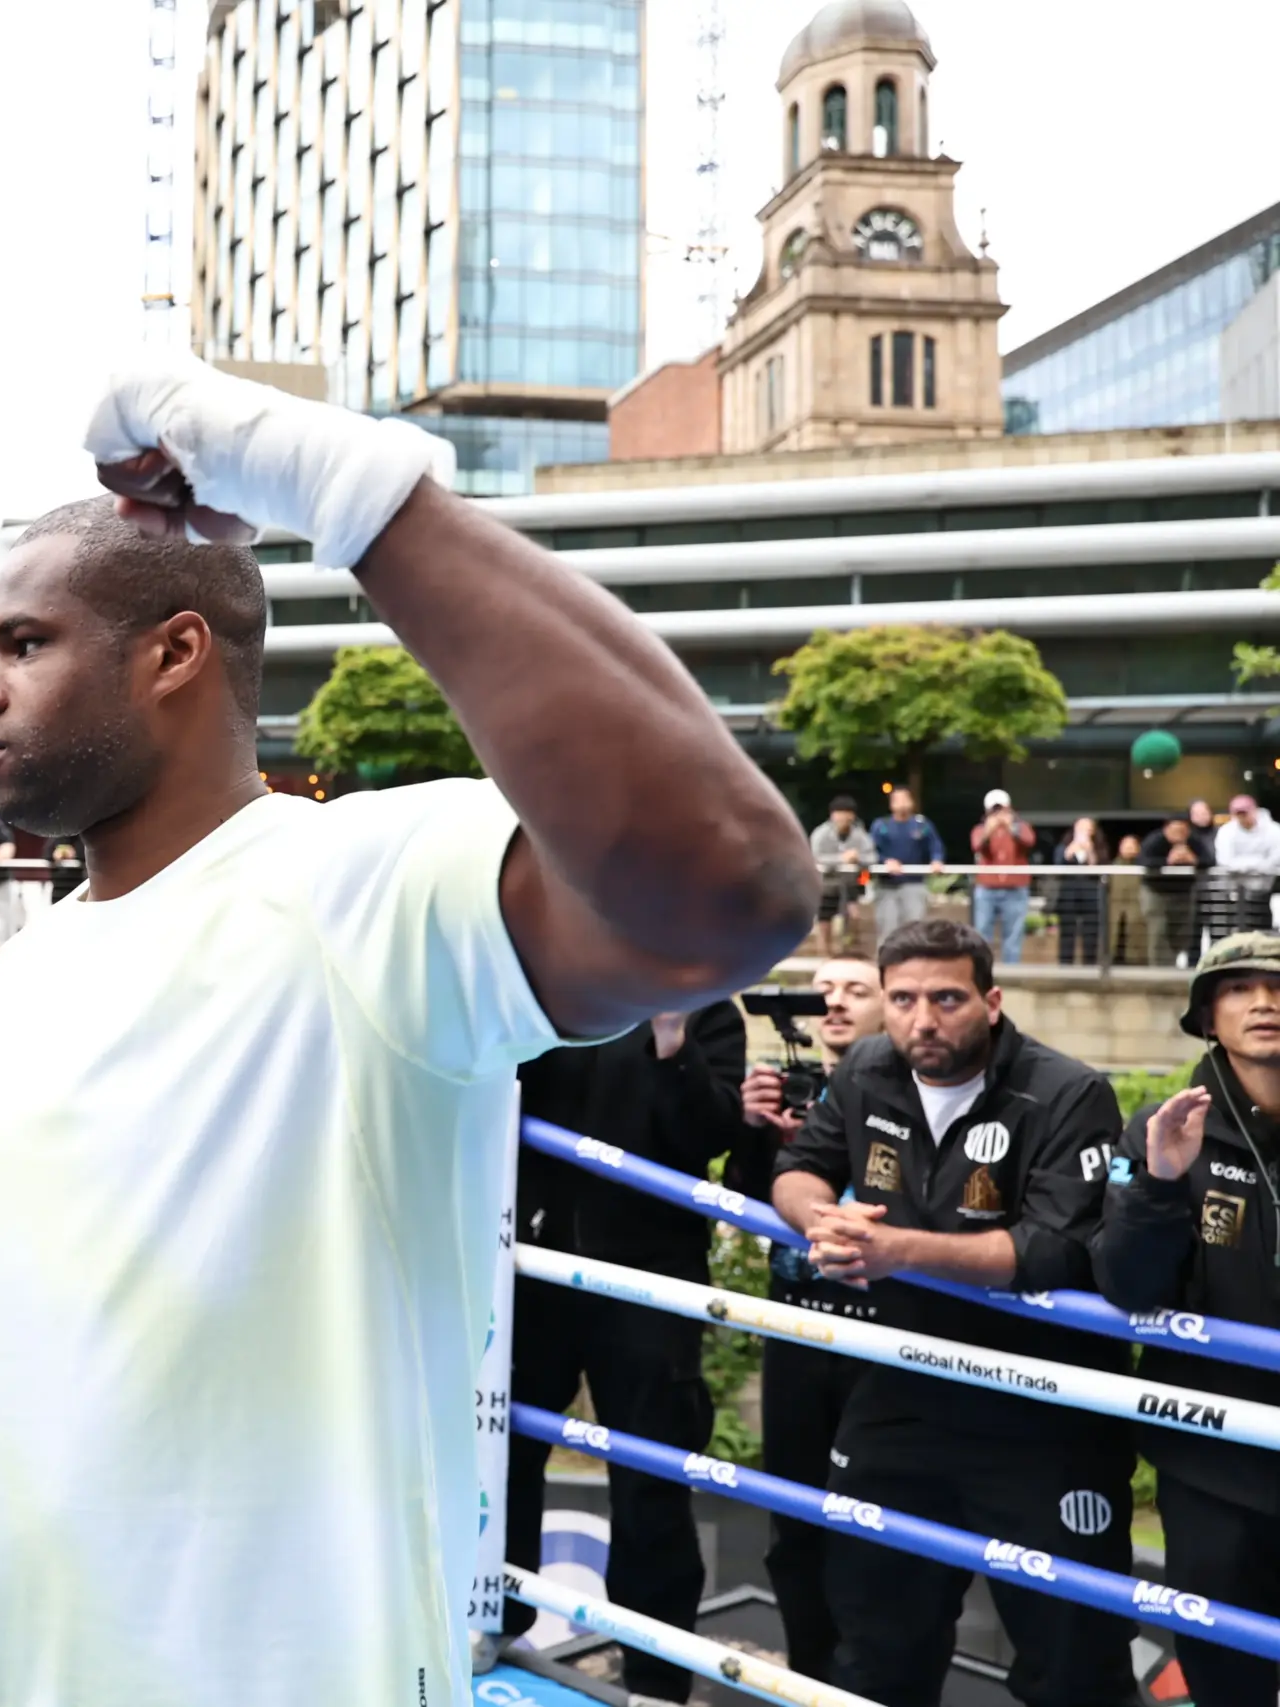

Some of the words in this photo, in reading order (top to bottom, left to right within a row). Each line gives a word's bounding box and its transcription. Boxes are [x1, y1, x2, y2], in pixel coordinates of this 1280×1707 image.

[899, 1345, 953, 1370] Global
[957, 1357, 1002, 1383] Next
[1006, 1367, 1058, 1394] Trade
[1137, 1393, 1228, 1432] DAZN
[562, 1418, 611, 1452] MrQ
[683, 1452, 739, 1489] MrQ
[822, 1492, 885, 1532] MrQ
[983, 1538, 1057, 1582] MrQ
[1132, 1579, 1216, 1627] MrQ
